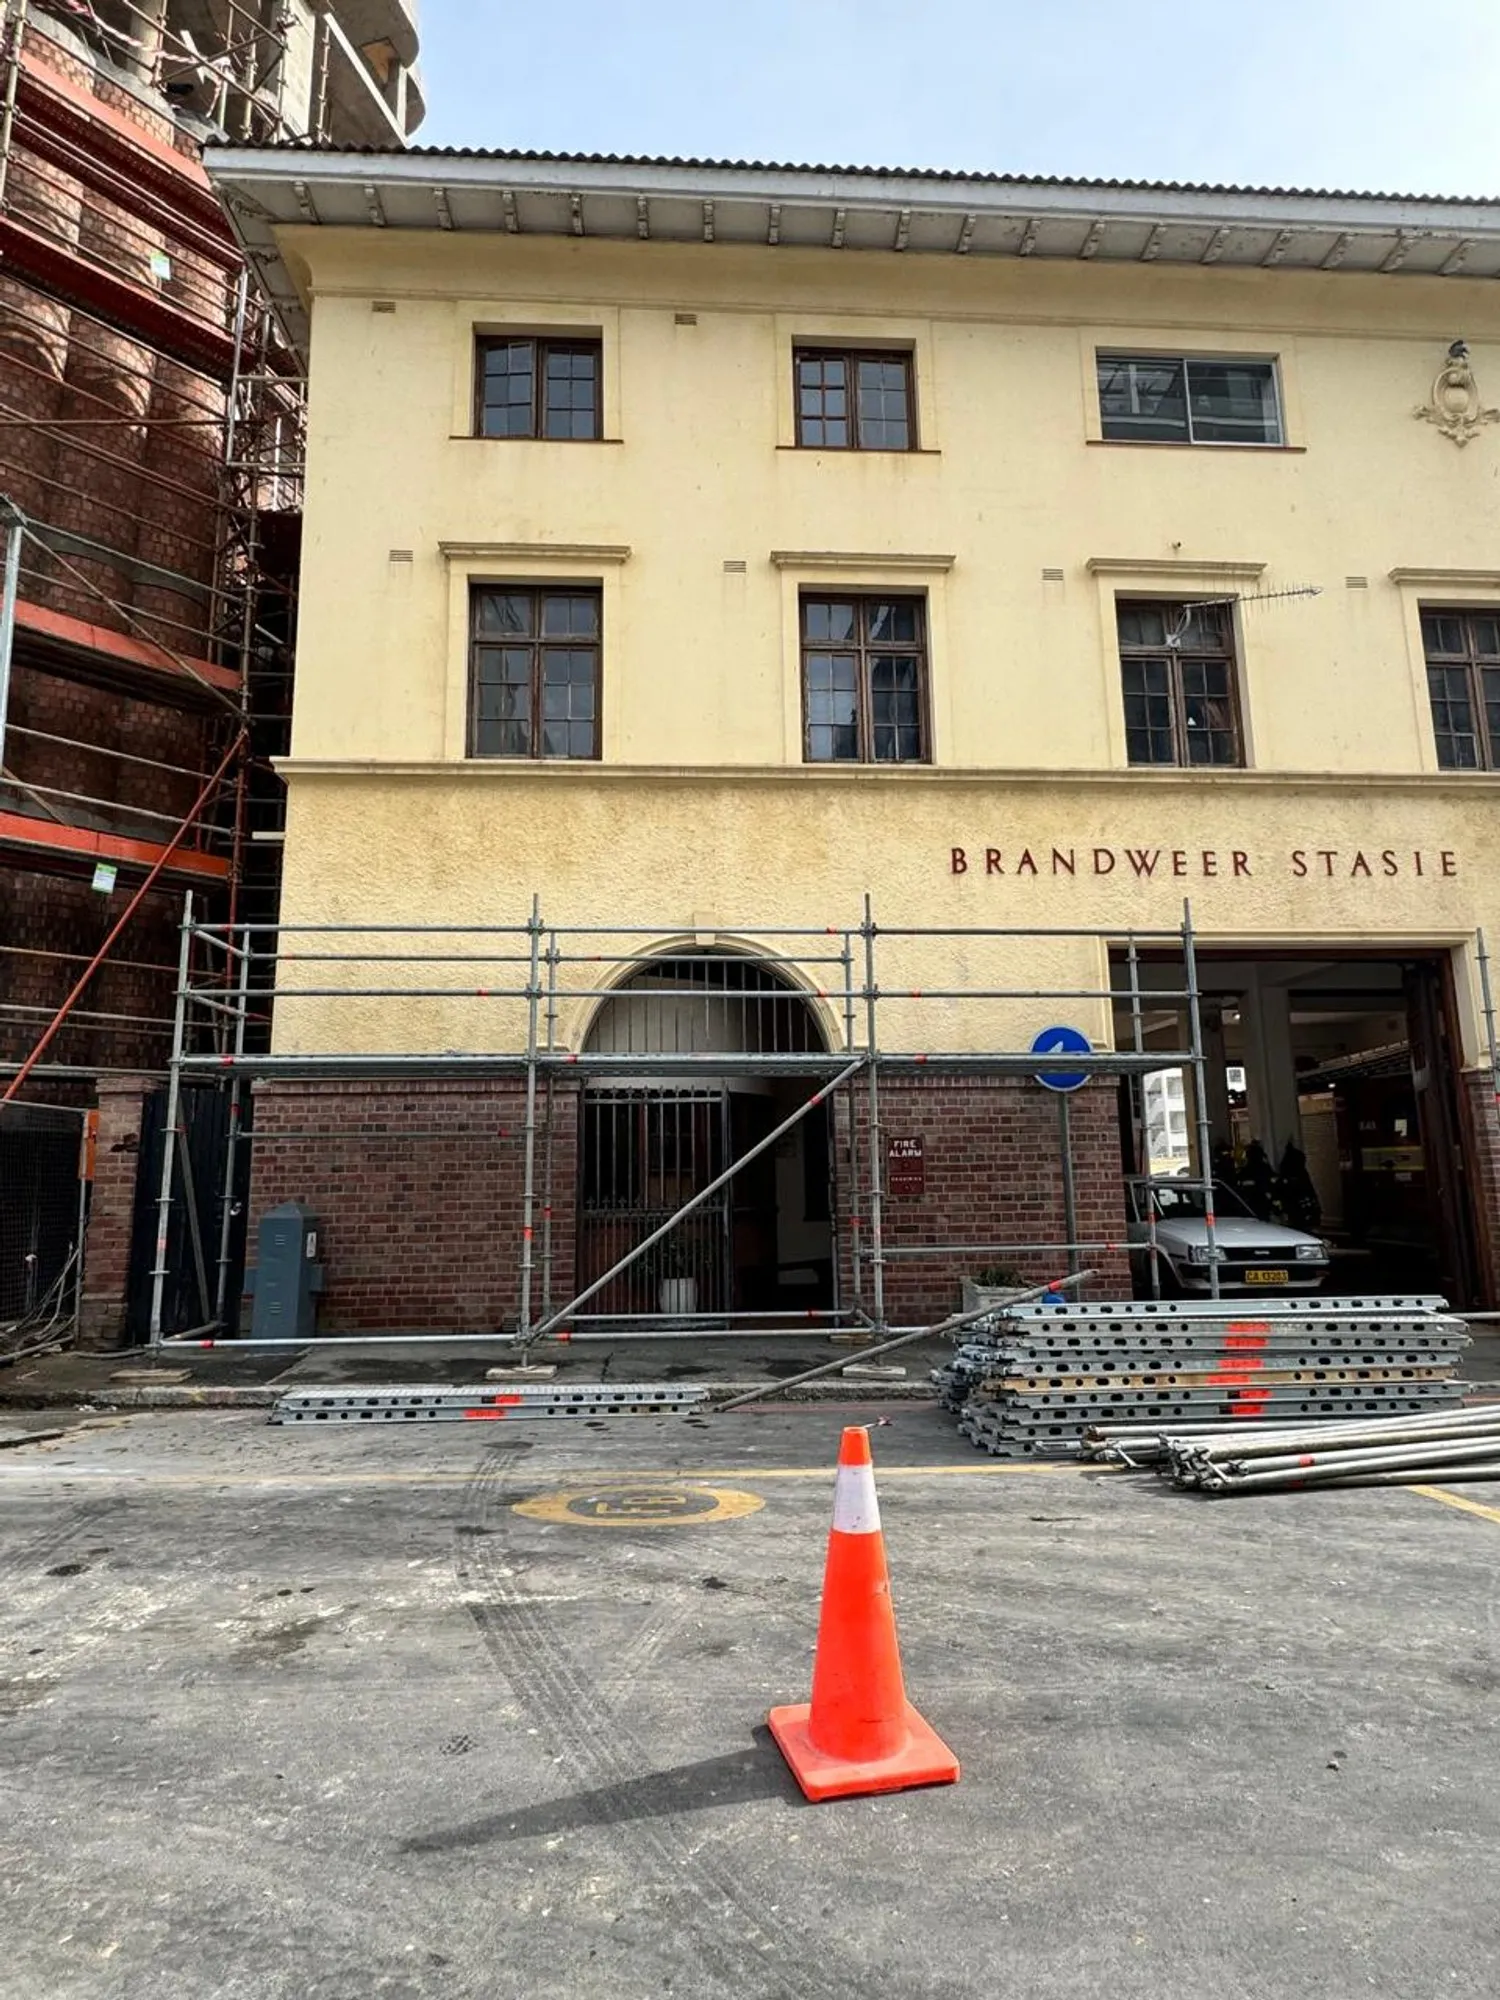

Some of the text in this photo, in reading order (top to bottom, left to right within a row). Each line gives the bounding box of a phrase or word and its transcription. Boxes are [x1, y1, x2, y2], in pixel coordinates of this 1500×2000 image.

[951, 847, 1457, 877] BRANDWEER STASIE
[893, 1139, 917, 1148] FIRE
[889, 1149, 922, 1158] ALARM
